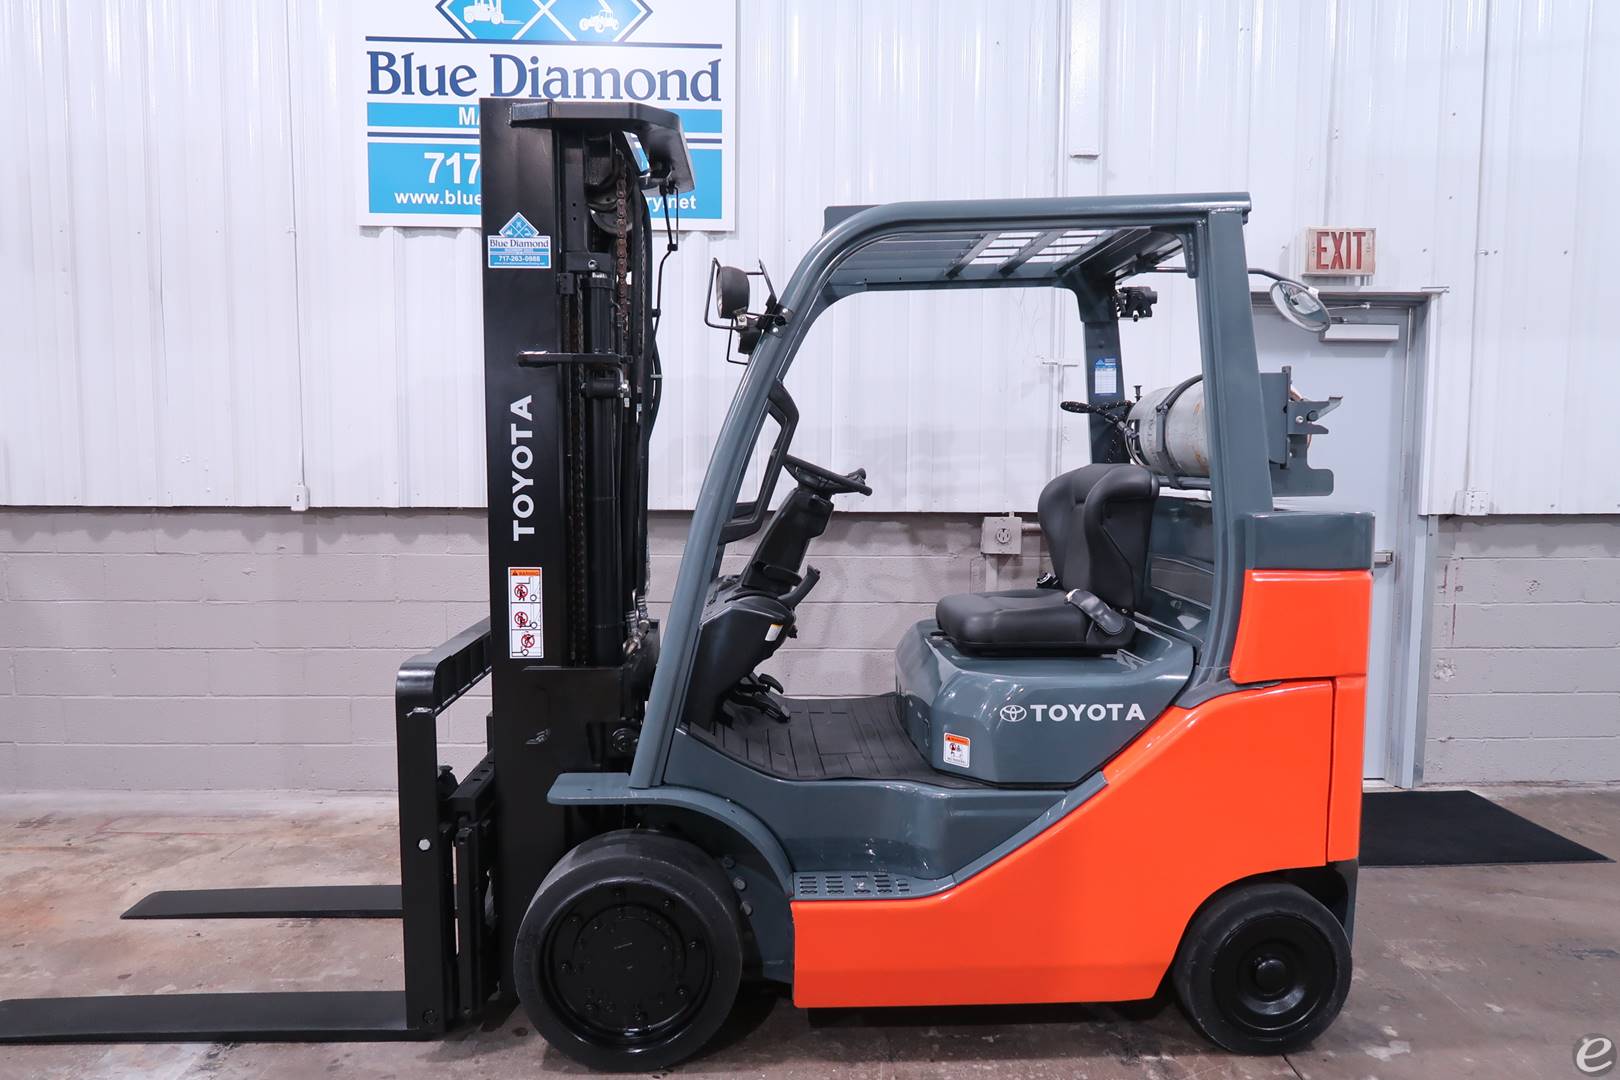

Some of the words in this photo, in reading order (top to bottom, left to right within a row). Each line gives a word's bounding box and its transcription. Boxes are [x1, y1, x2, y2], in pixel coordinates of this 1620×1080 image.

[367, 50, 477, 97] Blue
[490, 53, 722, 102] Diamond
[1316, 231, 1366, 270] EXIT
[510, 395, 535, 542] TOYOTA
[1030, 703, 1146, 722] TOYOTA
